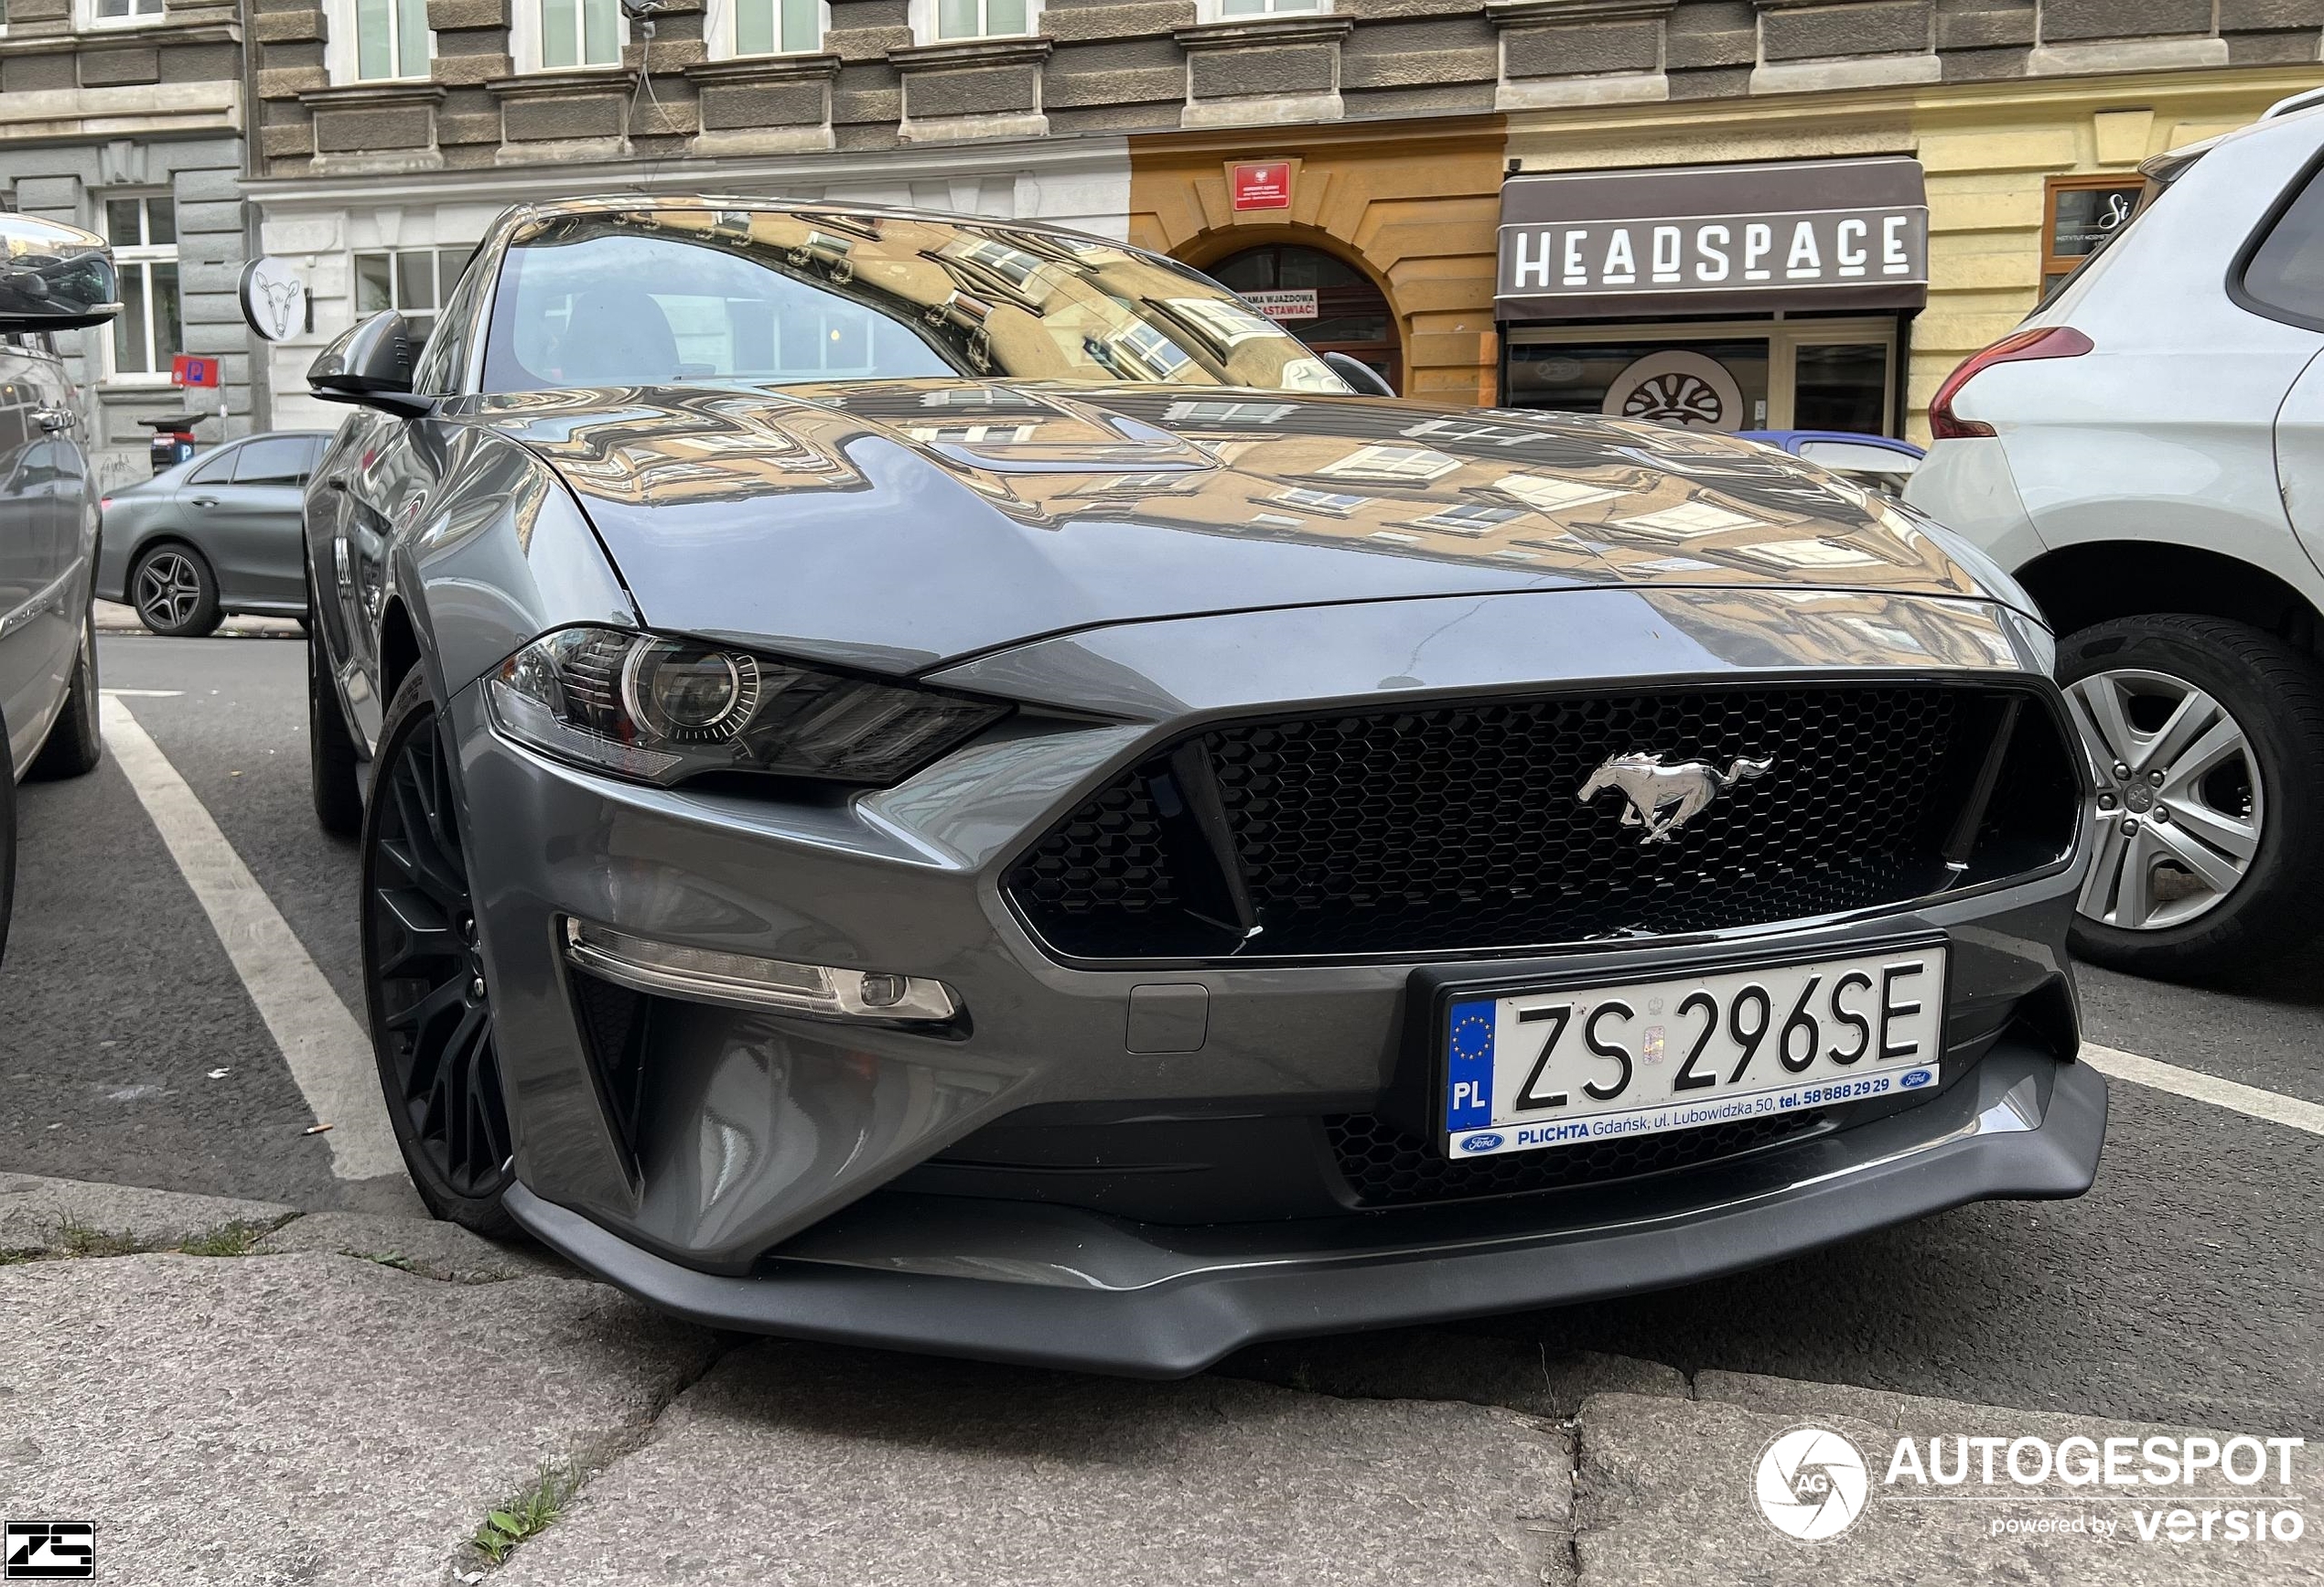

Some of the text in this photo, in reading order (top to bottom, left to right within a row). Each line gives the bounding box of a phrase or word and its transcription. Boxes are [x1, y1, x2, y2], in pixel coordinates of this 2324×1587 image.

[1514, 215, 1910, 287] HEADSPACE
[1266, 295, 1315, 304] WJAZDOWA
[1514, 960, 1924, 1111] ZS 296SE
[1453, 1080, 1486, 1110] PL
[1518, 1123, 1589, 1145] PLICHTA
[1593, 1117, 1651, 1135] Gdańsk,
[1654, 1113, 1670, 1128] ul.
[1673, 1101, 1752, 1125] Lubowidzka
[1756, 1099, 1776, 1113] 50,
[1779, 1092, 1801, 1109] tel.
[1803, 1088, 1821, 1104] 58
[1824, 1084, 1851, 1101] 888
[1854, 1081, 1871, 1096] 29
[1872, 1078, 1889, 1093] 29
